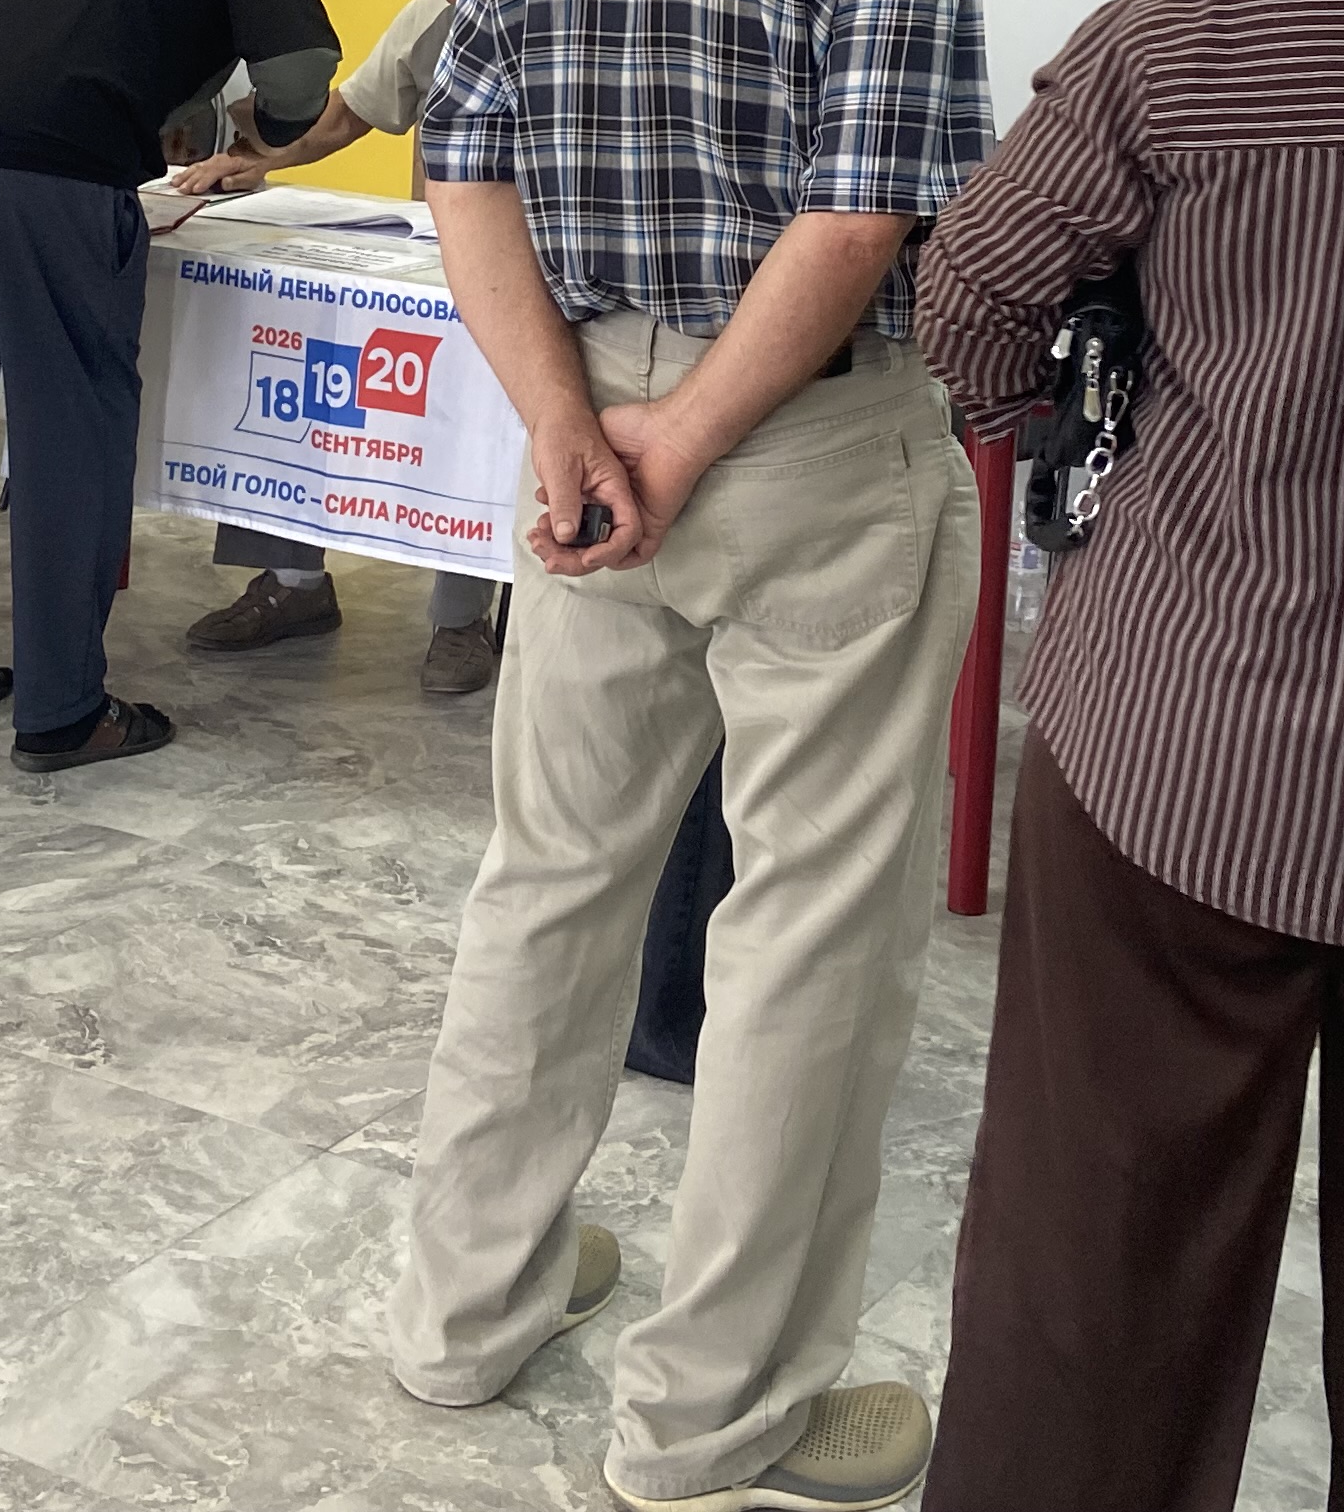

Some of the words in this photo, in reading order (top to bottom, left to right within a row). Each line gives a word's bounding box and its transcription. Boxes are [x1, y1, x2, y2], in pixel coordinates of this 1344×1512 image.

[181, 260, 274, 294] ЕДИНЫЙ
[278, 277, 336, 304] ДЕНЬ
[340, 288, 462, 323] ГОЛОСОВА
[251, 325, 303, 350] 2026
[257, 376, 299, 423] 18
[311, 361, 352, 409] 19
[365, 347, 424, 396] 20
[311, 429, 423, 467] СЕНТЯБРЯ
[165, 461, 226, 490] ТВОЙ
[232, 473, 306, 505] ГОЛОС
[324, 493, 390, 522] СИЛА
[395, 505, 494, 542] РОССИИ!
